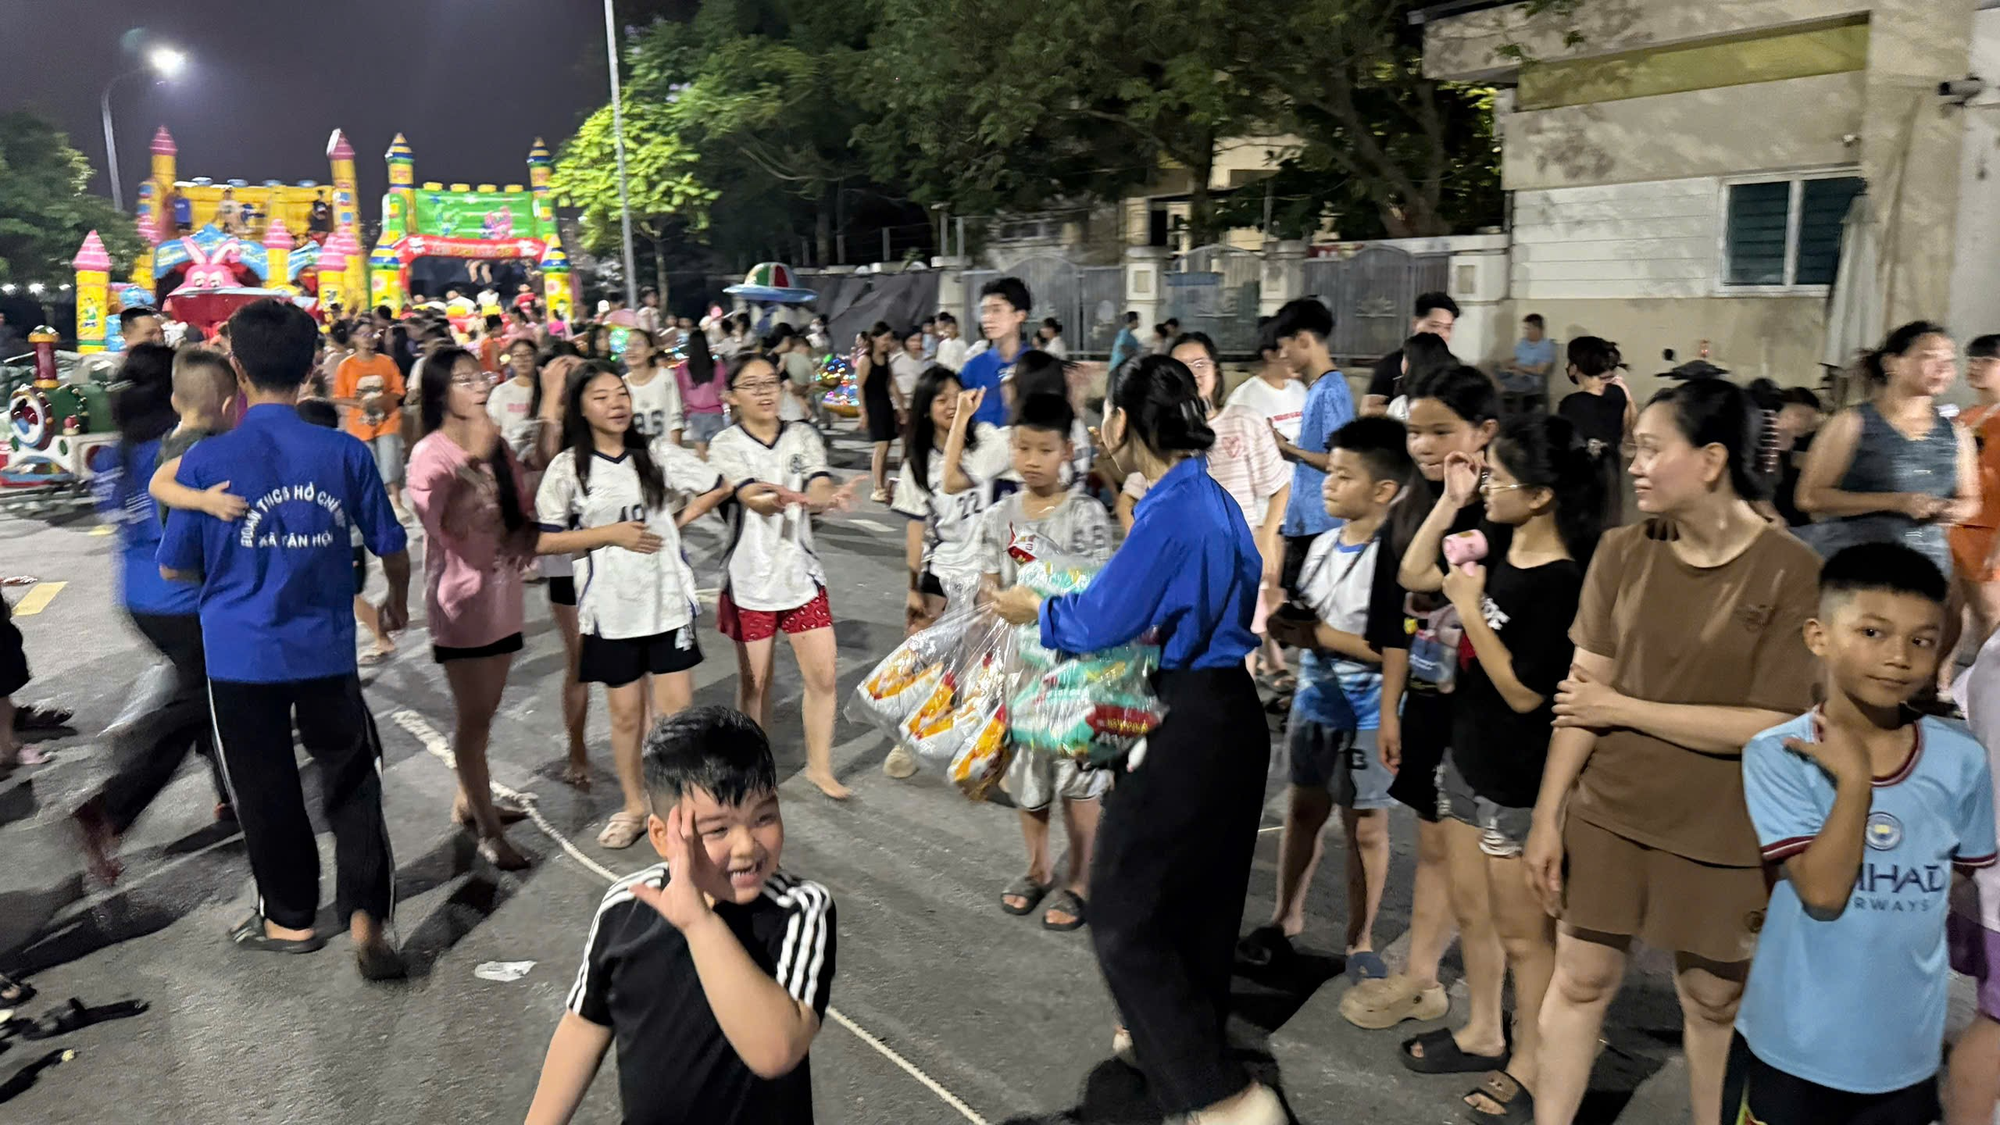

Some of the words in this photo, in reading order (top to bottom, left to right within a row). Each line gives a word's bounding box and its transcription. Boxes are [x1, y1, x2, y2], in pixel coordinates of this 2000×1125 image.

[956, 490, 983, 520] 22
[1857, 862, 1946, 893] IHAD
[1853, 896, 1929, 912] RWAYS
